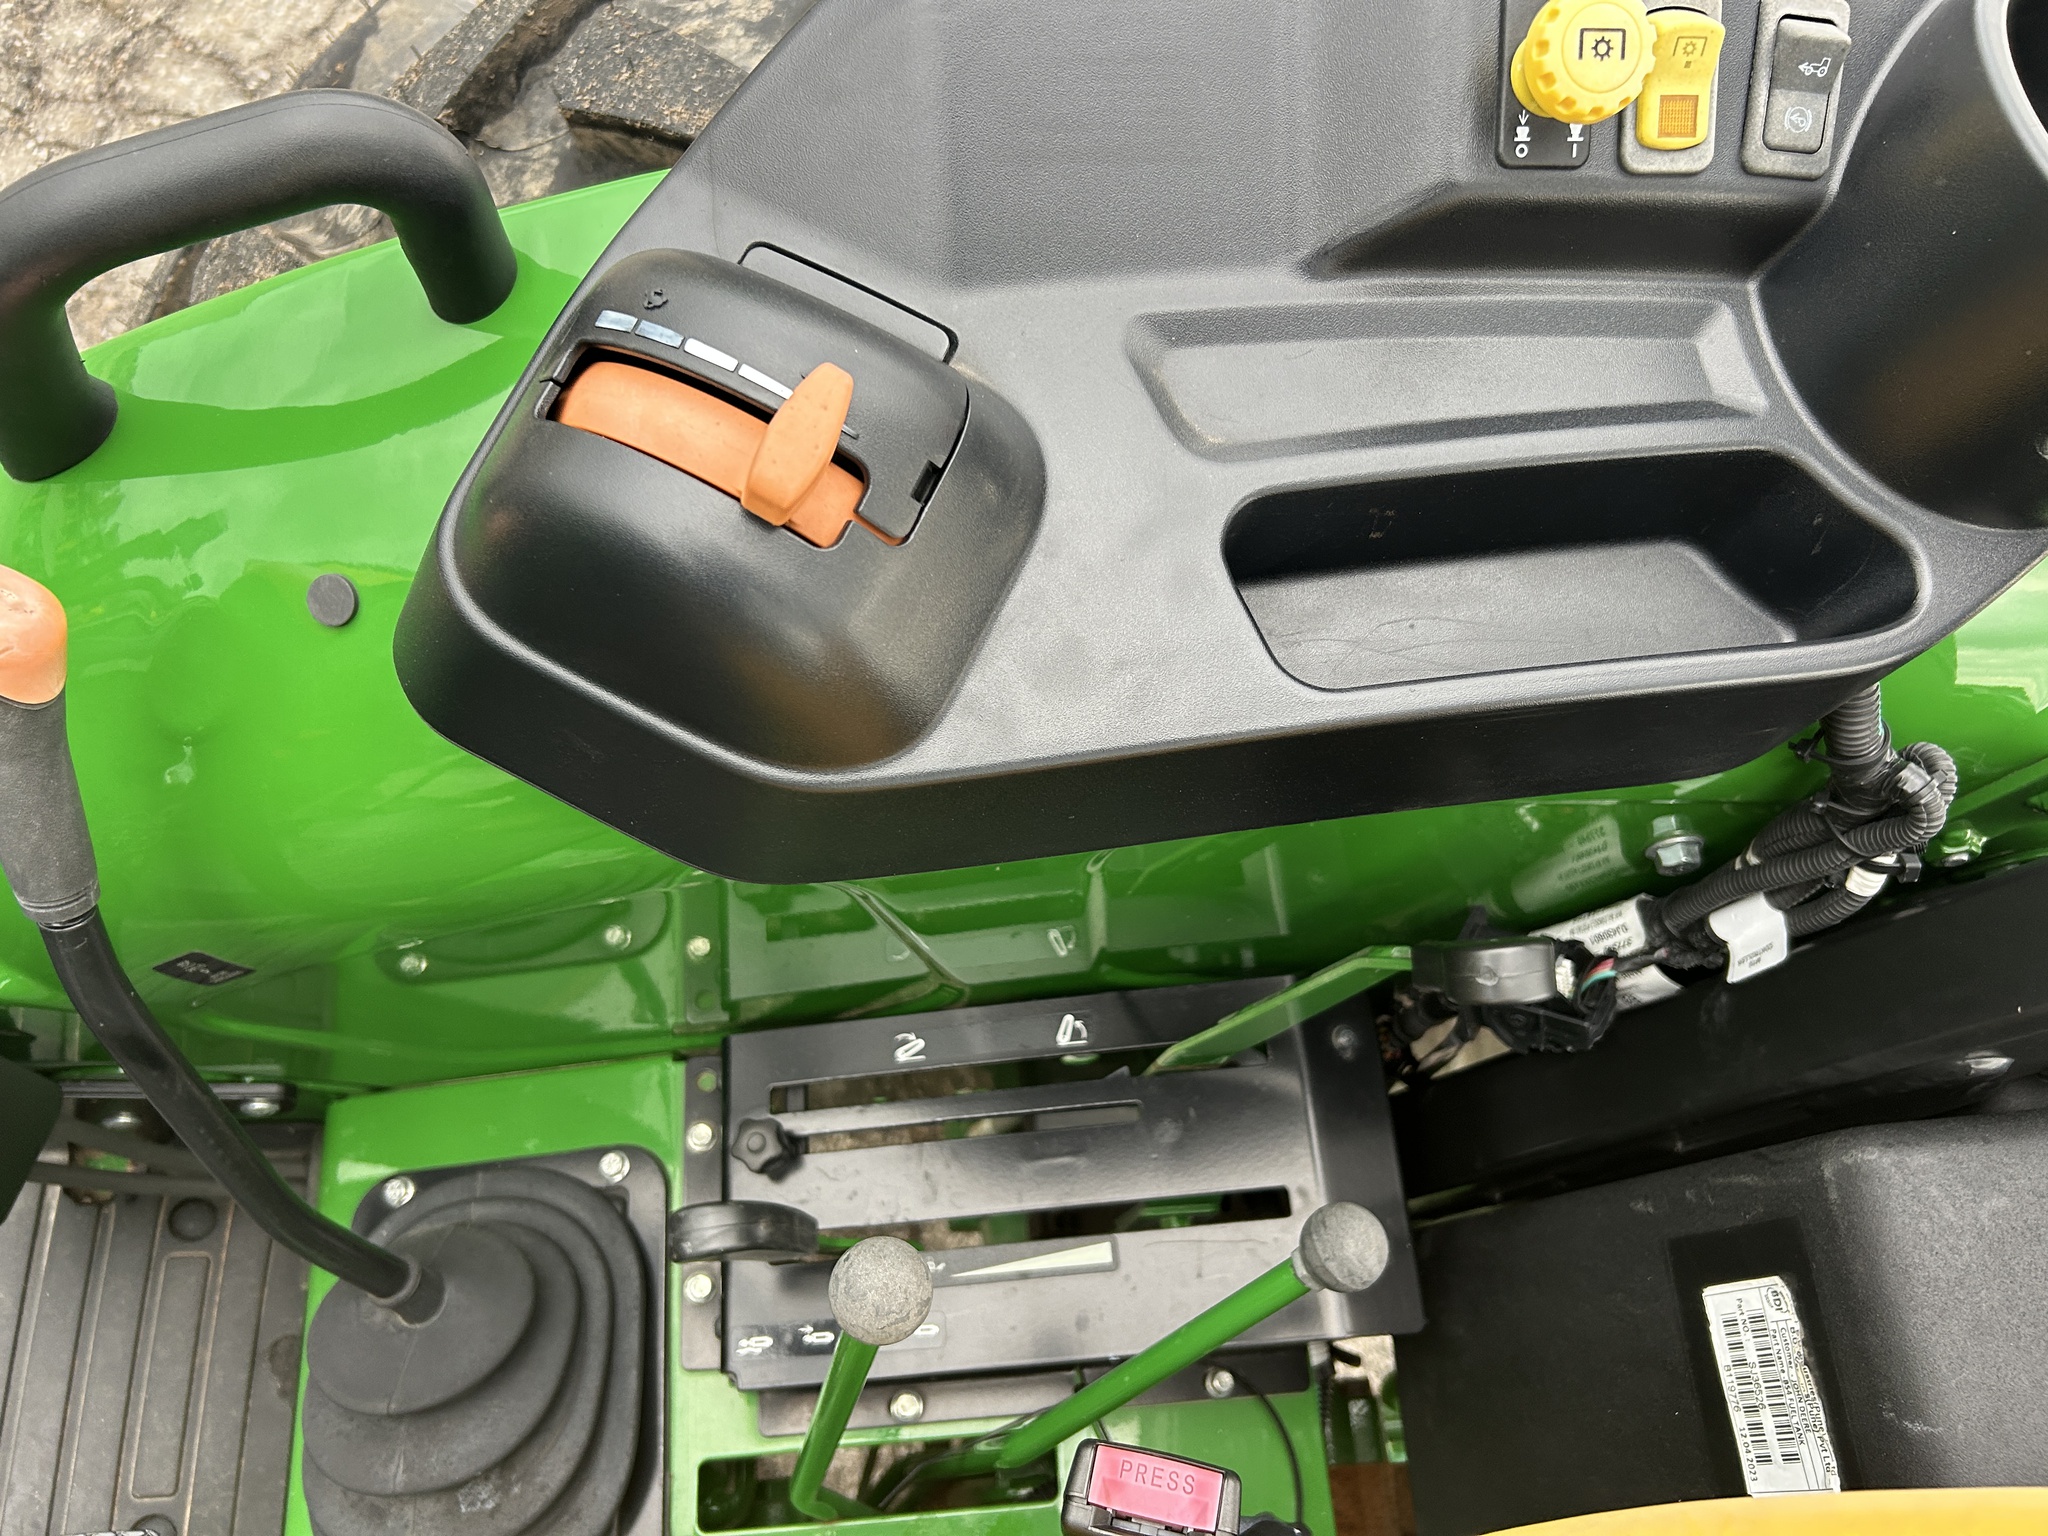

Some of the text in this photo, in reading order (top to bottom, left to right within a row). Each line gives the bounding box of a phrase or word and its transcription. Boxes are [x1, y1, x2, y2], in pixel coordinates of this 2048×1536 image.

[1736, 1298, 1745, 1317] Part
[1771, 1290, 1784, 1313] BDI
[1771, 1329, 1780, 1347] Part
[1776, 1349, 1786, 1374] Name
[1723, 1364, 1742, 1413] B119776
[1748, 1361, 1767, 1411] SJ36526
[1780, 1327, 1793, 1370] Customer
[1791, 1379, 1803, 1404] JOHN
[1799, 1406, 1812, 1434] DEERE
[1788, 1398, 1798, 1419] FUEL
[1792, 1422, 1806, 1446] TANK
[1738, 1427, 1758, 1482] 12.04.2023
[1120, 1459, 1195, 1495] PRESS
